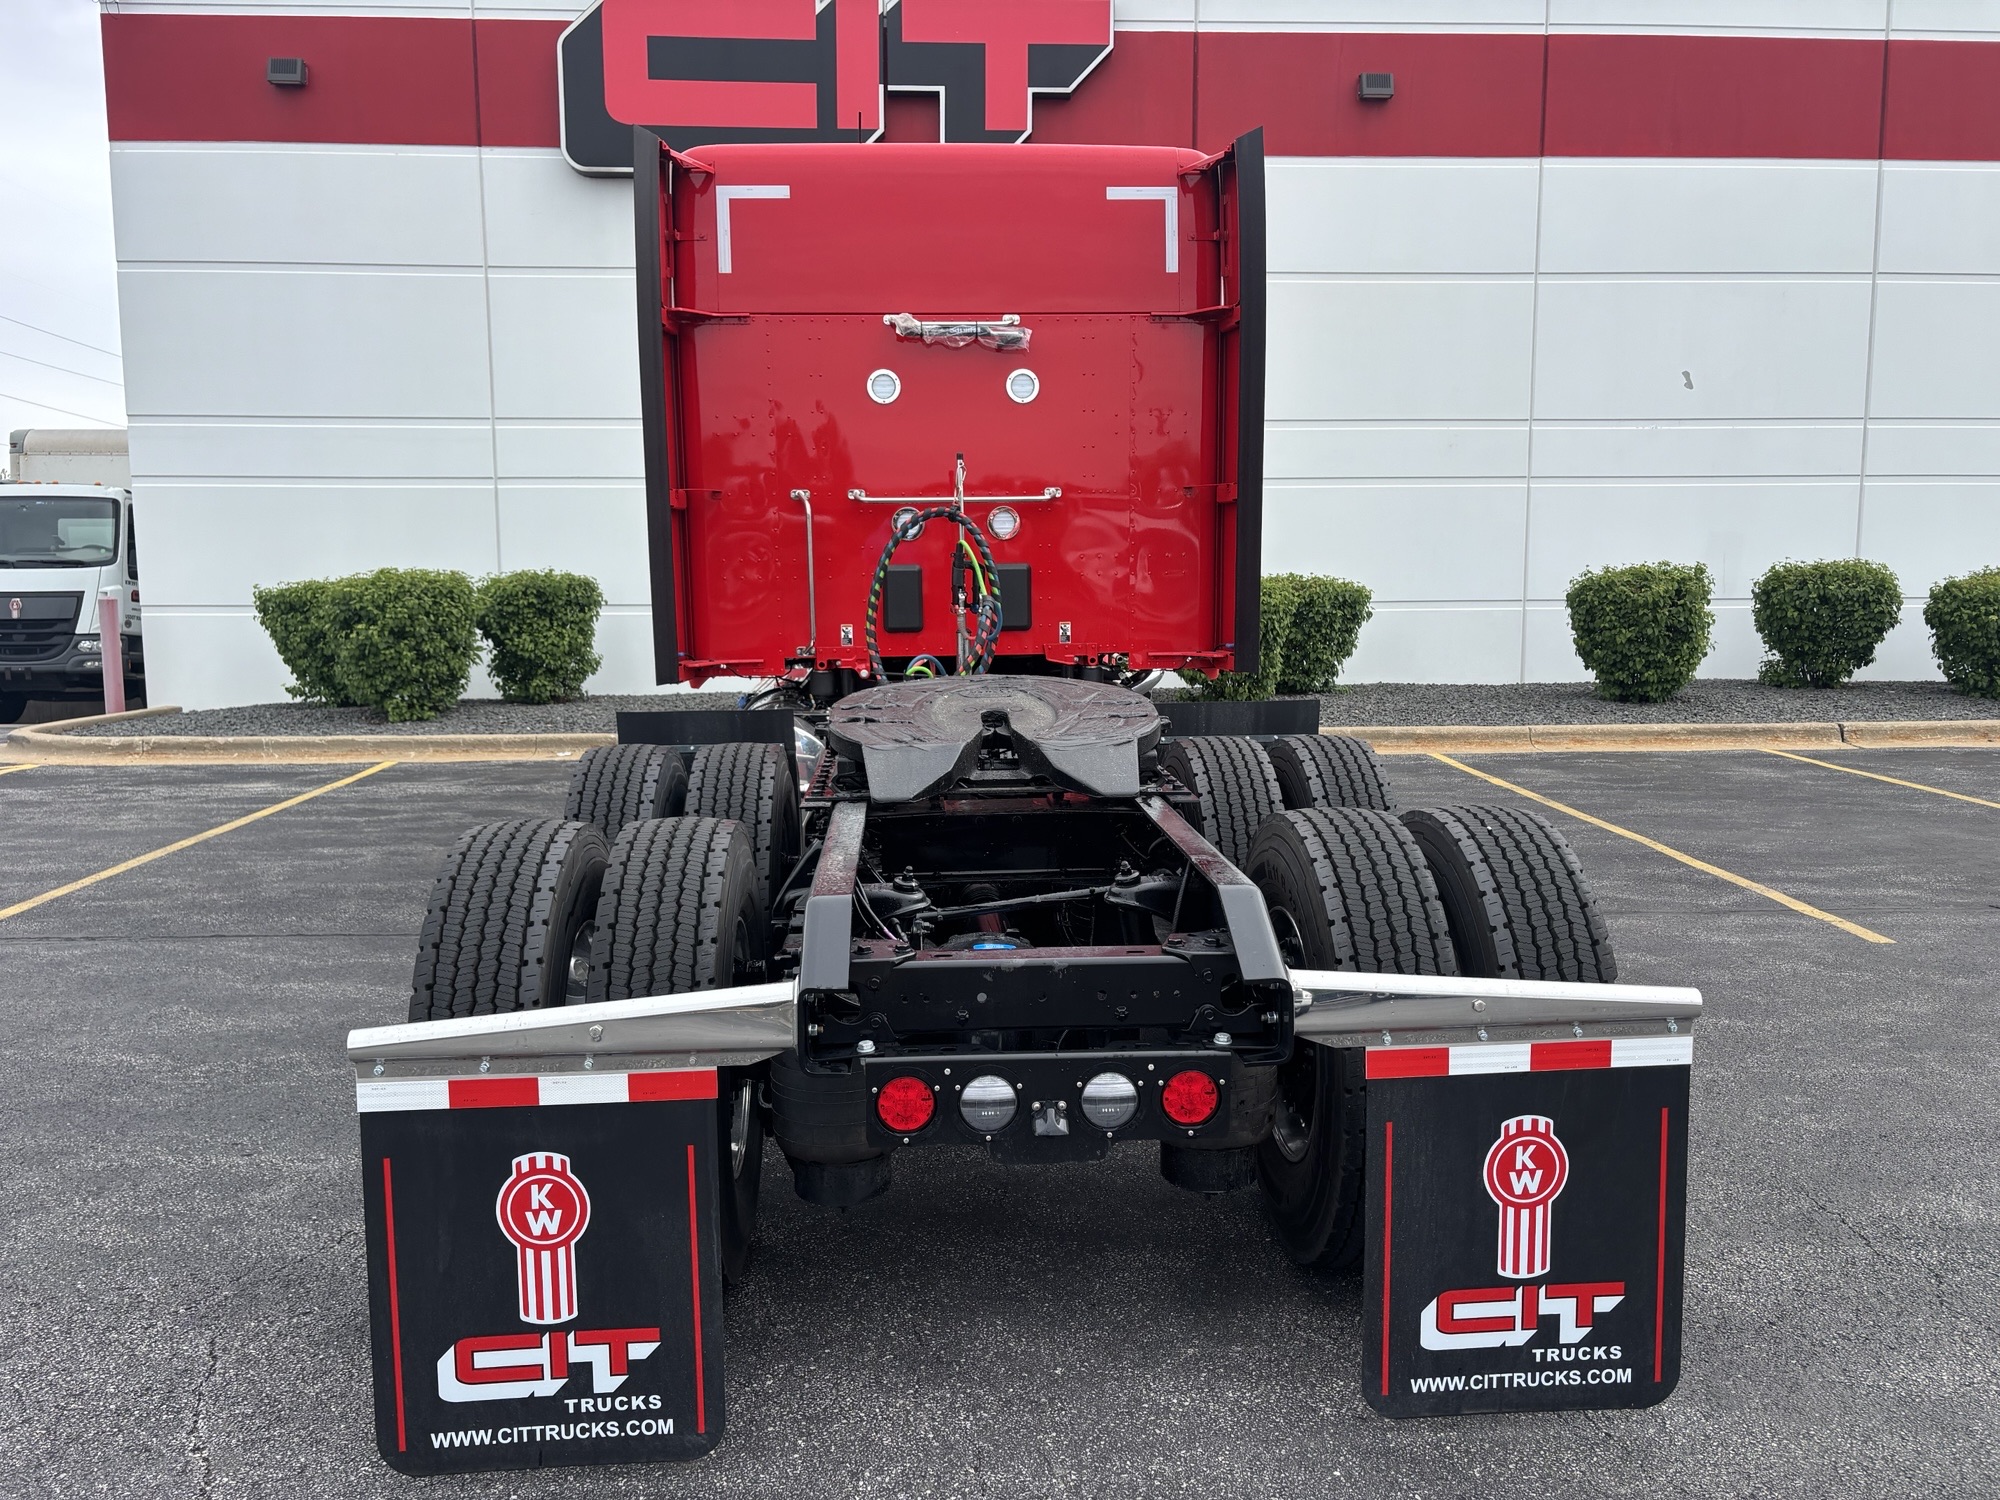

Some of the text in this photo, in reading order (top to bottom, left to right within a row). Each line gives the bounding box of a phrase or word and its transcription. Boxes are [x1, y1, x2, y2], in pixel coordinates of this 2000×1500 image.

[558, 0, 1115, 174] CIT
[1420, 1281, 1625, 1351] CIT
[437, 1328, 662, 1403] CIT
[1532, 1345, 1622, 1362] TRUCKS
[1410, 1367, 1632, 1394] WWW.CITTRUCKS.COM
[564, 1395, 662, 1414] TRUCKS
[430, 1418, 674, 1449] WWW.CITTRUCKS.COM
